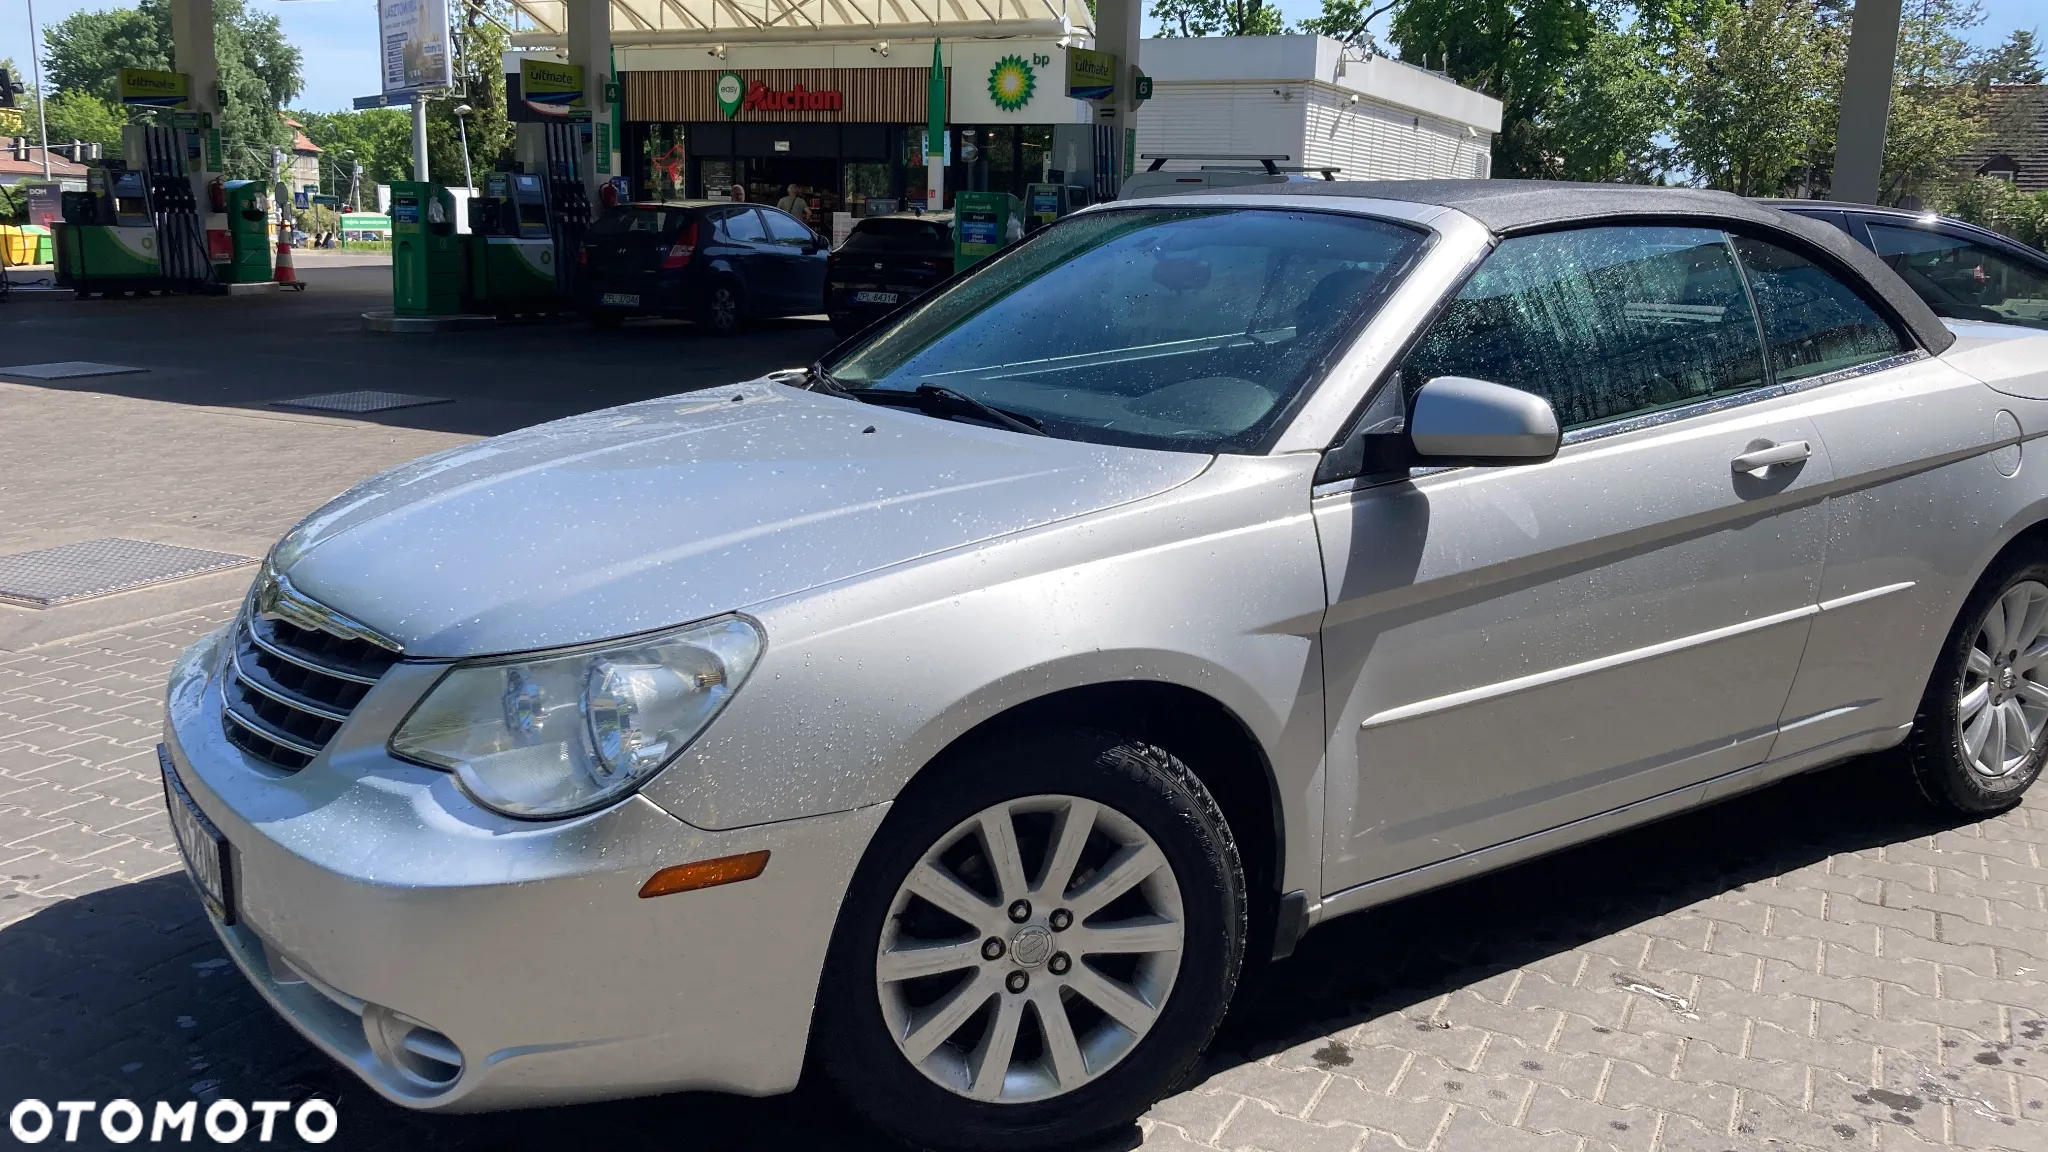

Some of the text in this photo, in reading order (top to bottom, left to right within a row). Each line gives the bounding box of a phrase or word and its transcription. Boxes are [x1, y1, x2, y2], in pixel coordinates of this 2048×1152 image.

[1033, 53, 1050, 68] bp
[1075, 59, 1109, 77] ultimate
[608, 88, 616, 99] 4
[720, 85, 738, 94] easy
[1139, 82, 1148, 95] 6
[219, 92, 226, 102] 2
[744, 80, 842, 111] Auchan
